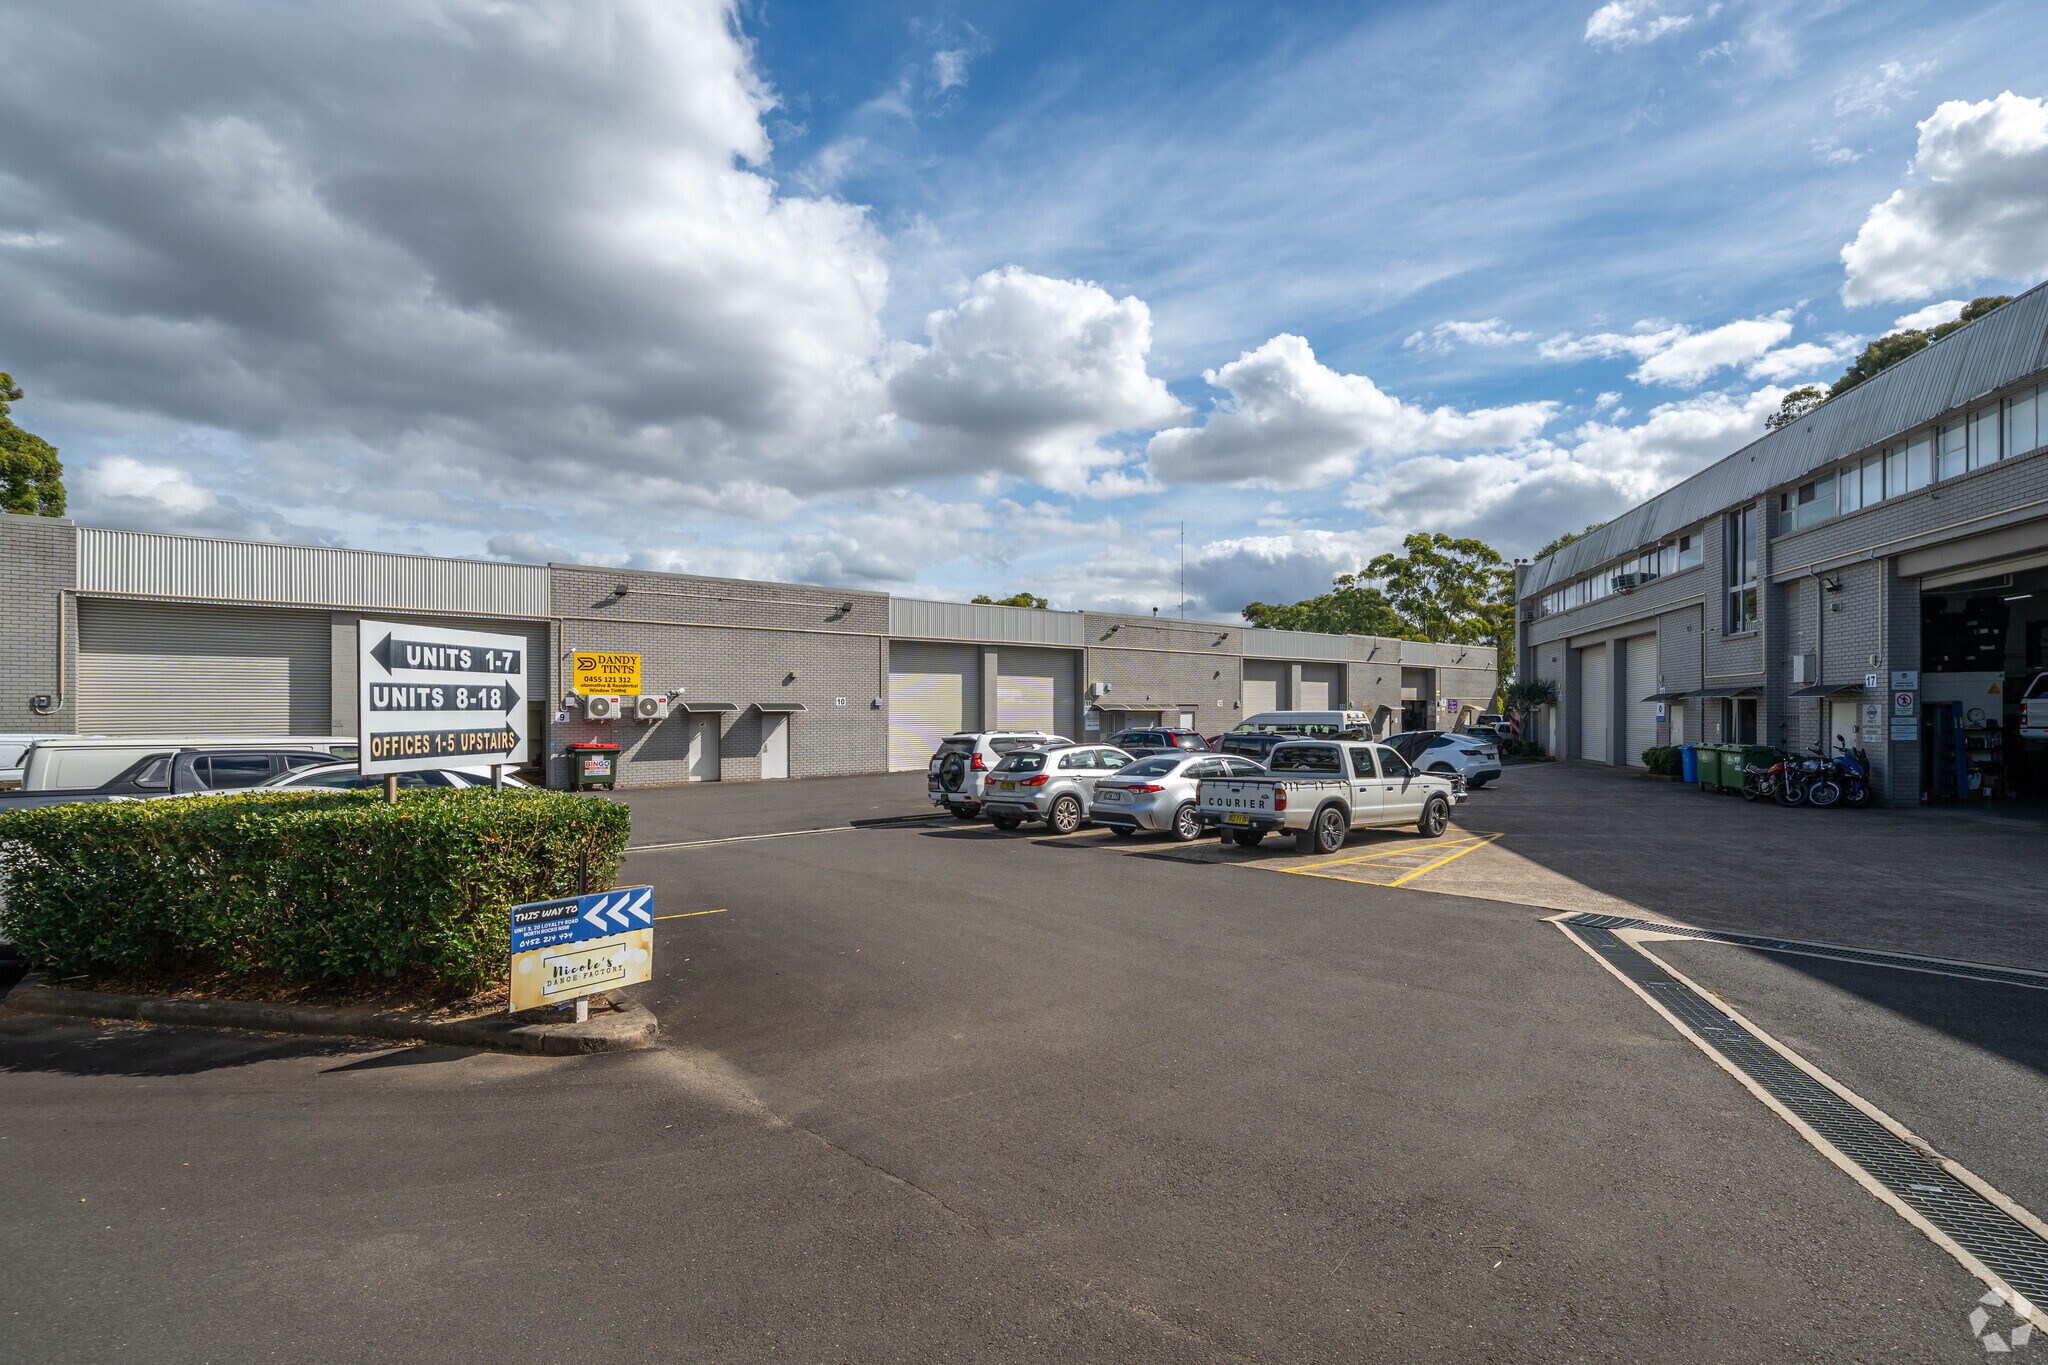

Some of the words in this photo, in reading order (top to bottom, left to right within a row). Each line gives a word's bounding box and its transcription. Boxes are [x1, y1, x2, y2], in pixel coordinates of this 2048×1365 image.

[406, 645, 472, 670] UNITS
[485, 651, 513, 671] 1-7
[598, 655, 637, 664] DANDY
[601, 665, 634, 674] TINTS
[1866, 676, 1875, 686] 17
[373, 687, 444, 708] UNITS
[456, 688, 501, 709] 8-18
[559, 713, 565, 721] 9
[371, 734, 430, 757] OFFICES
[435, 733, 455, 752] 1-5
[460, 731, 516, 751] UPSTAIRS
[1208, 797, 1265, 809] COURIER
[514, 910, 540, 922] THIS
[541, 907, 564, 918] WAY
[565, 905, 578, 914] TO
[514, 926, 527, 934] UNIT
[541, 920, 564, 929] LOYALTY
[519, 938, 541, 948] 0452
[553, 957, 613, 978] Nicole's
[547, 974, 578, 987] DANCE
[583, 964, 623, 979] FACTORY
